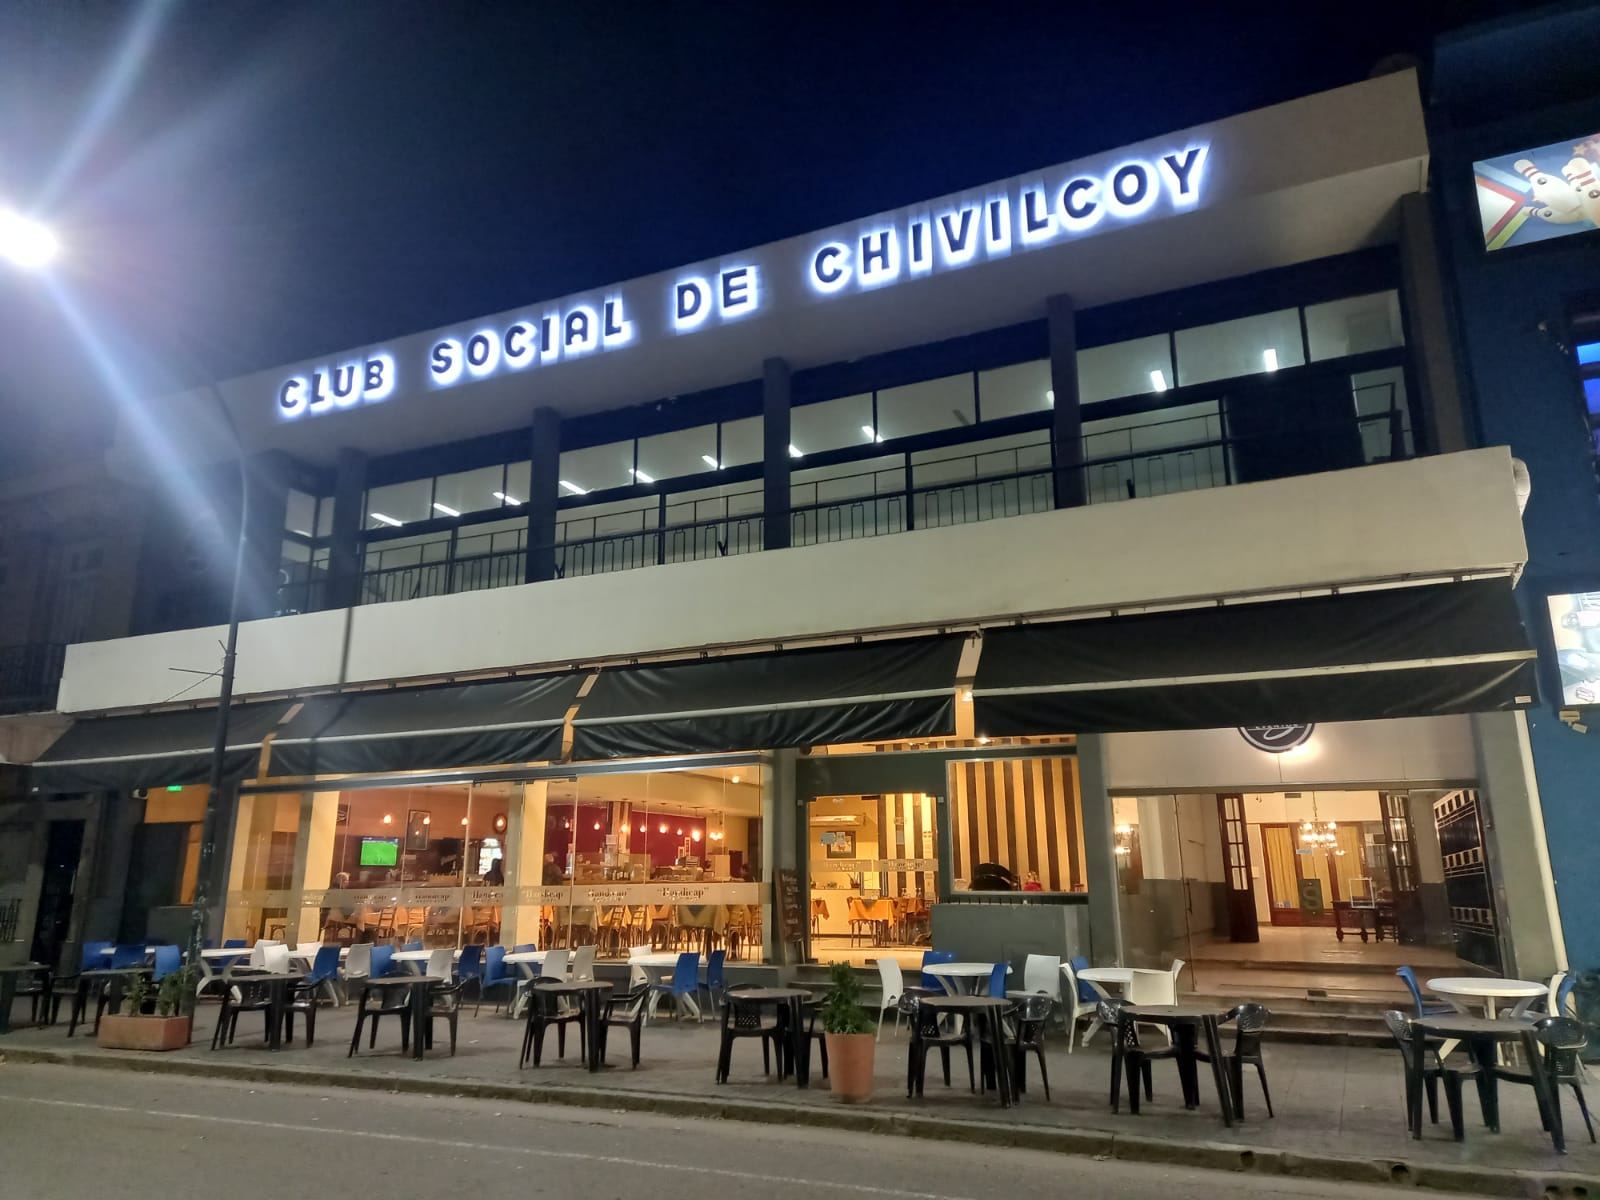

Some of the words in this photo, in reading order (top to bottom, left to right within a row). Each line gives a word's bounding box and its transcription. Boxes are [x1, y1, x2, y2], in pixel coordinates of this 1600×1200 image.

[280, 359, 385, 409] CLUB
[431, 301, 621, 375] SOCIAL
[677, 267, 748, 319] DE
[814, 148, 1201, 283] CHIVILCOY
